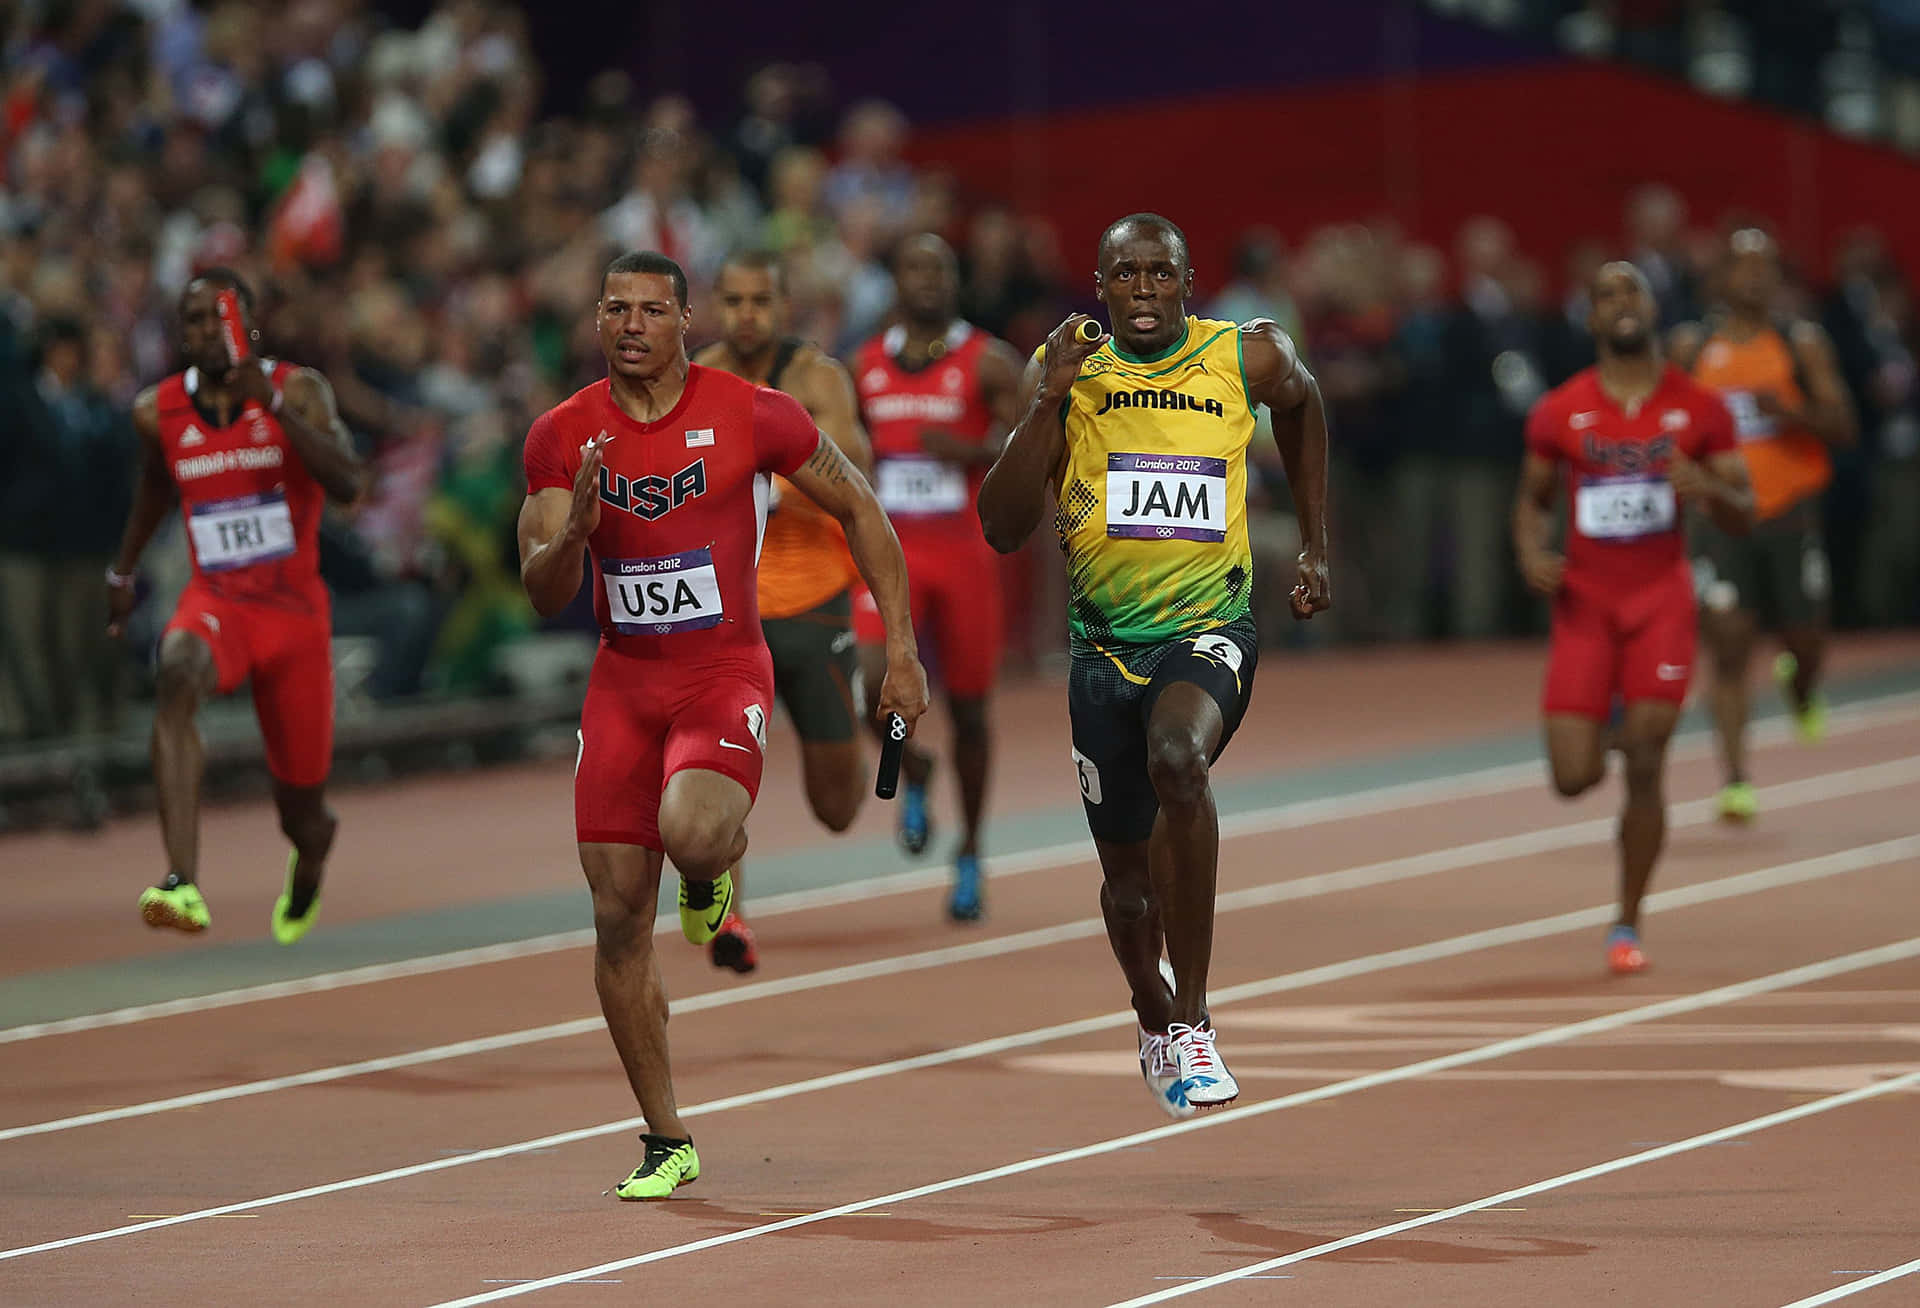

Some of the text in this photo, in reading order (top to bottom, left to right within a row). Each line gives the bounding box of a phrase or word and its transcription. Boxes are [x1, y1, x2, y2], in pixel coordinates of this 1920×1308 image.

[1135, 458, 1201, 472] London 2012
[599, 457, 707, 521] USA
[1122, 480, 1210, 521] JAM
[216, 516, 265, 552] TRI
[620, 557, 681, 574] London 2012
[618, 579, 703, 617] USA
[1209, 642, 1229, 659] 6
[1077, 759, 1090, 794] 6
